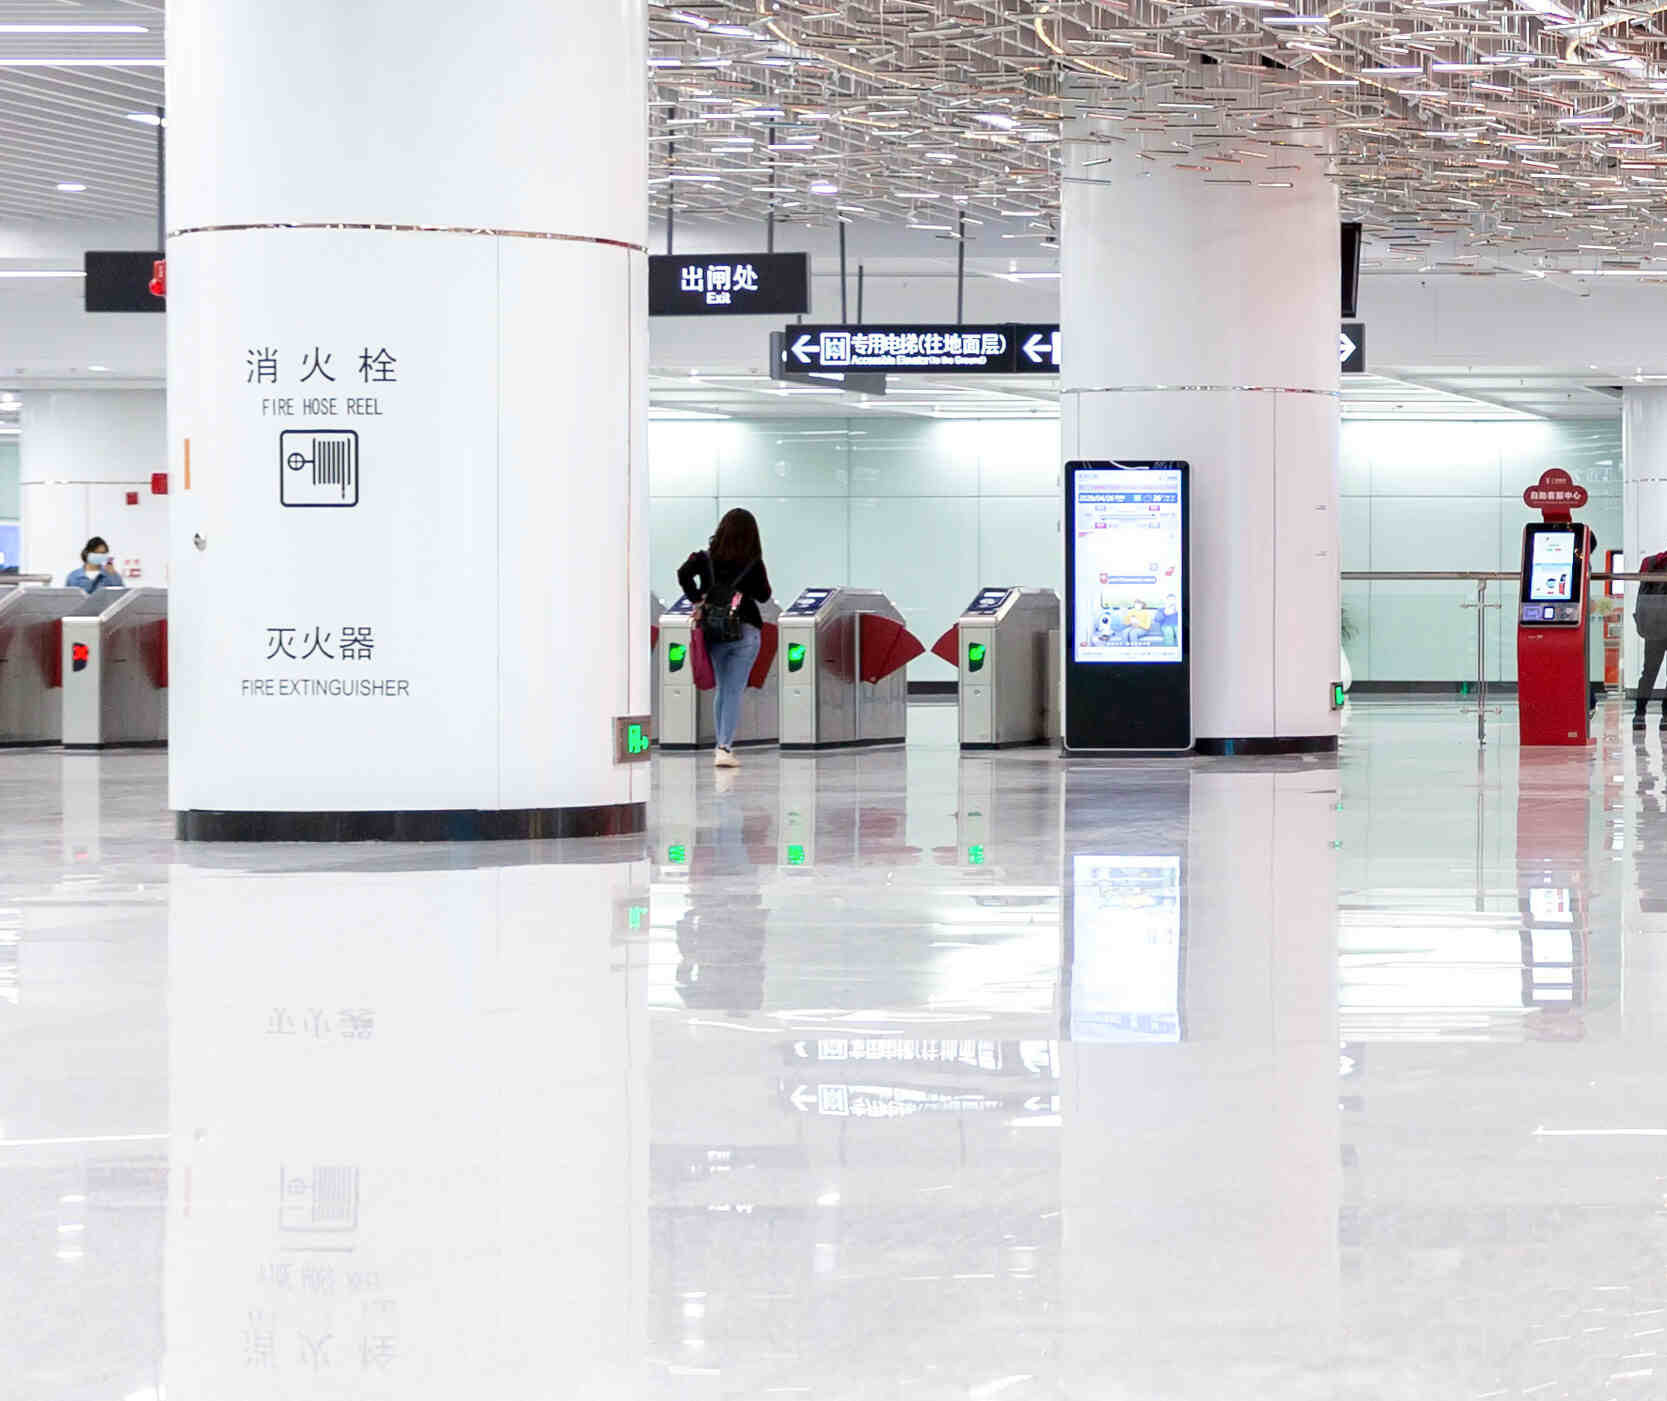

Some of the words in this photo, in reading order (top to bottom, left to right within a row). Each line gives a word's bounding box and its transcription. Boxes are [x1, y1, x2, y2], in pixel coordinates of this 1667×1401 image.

[680, 264, 758, 292] 出闸处
[705, 292, 732, 305] Exit
[850, 333, 1007, 355] 专用电梯(往地面层)
[246, 346, 397, 384] 消火栓
[262, 398, 295, 416] FIRE
[302, 398, 338, 416] HOSE
[346, 398, 383, 416] REEL
[266, 626, 375, 661] 灭火器
[242, 679, 274, 697] FIRE
[279, 679, 410, 697] EXTINGUISHER
